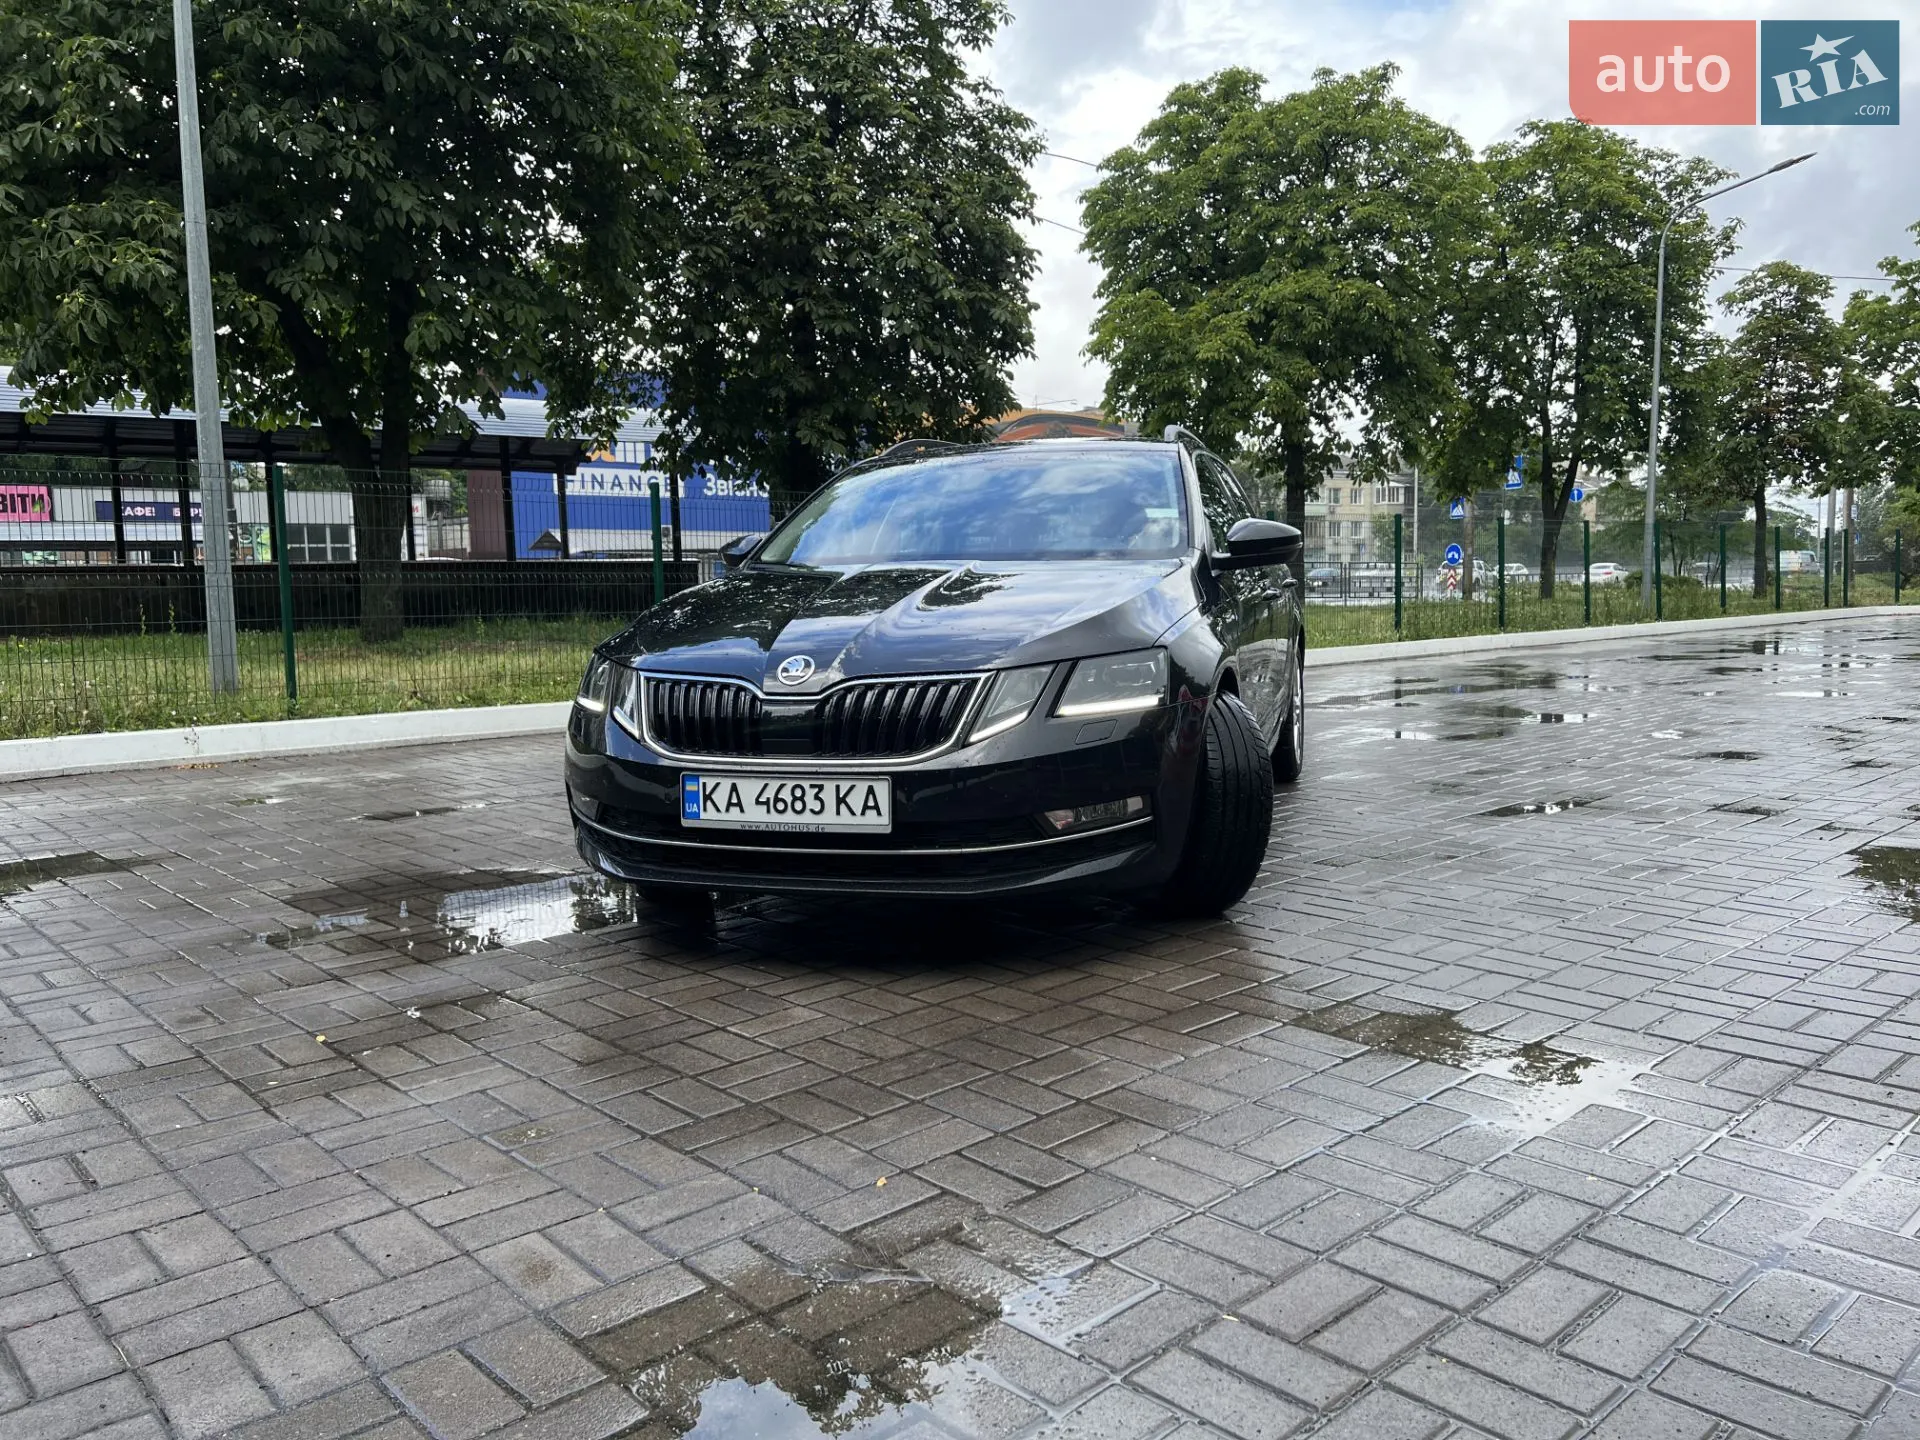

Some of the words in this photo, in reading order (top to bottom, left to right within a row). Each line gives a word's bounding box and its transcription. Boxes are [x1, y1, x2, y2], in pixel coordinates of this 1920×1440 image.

[121, 507, 156, 517] АФЕ!
[173, 508, 203, 518] БР!
[702, 781, 745, 813] KA
[755, 782, 826, 815] 4683
[835, 783, 883, 816] KA
[686, 803, 699, 813] UA
[740, 824, 826, 832] www.AUTOHUS.de
